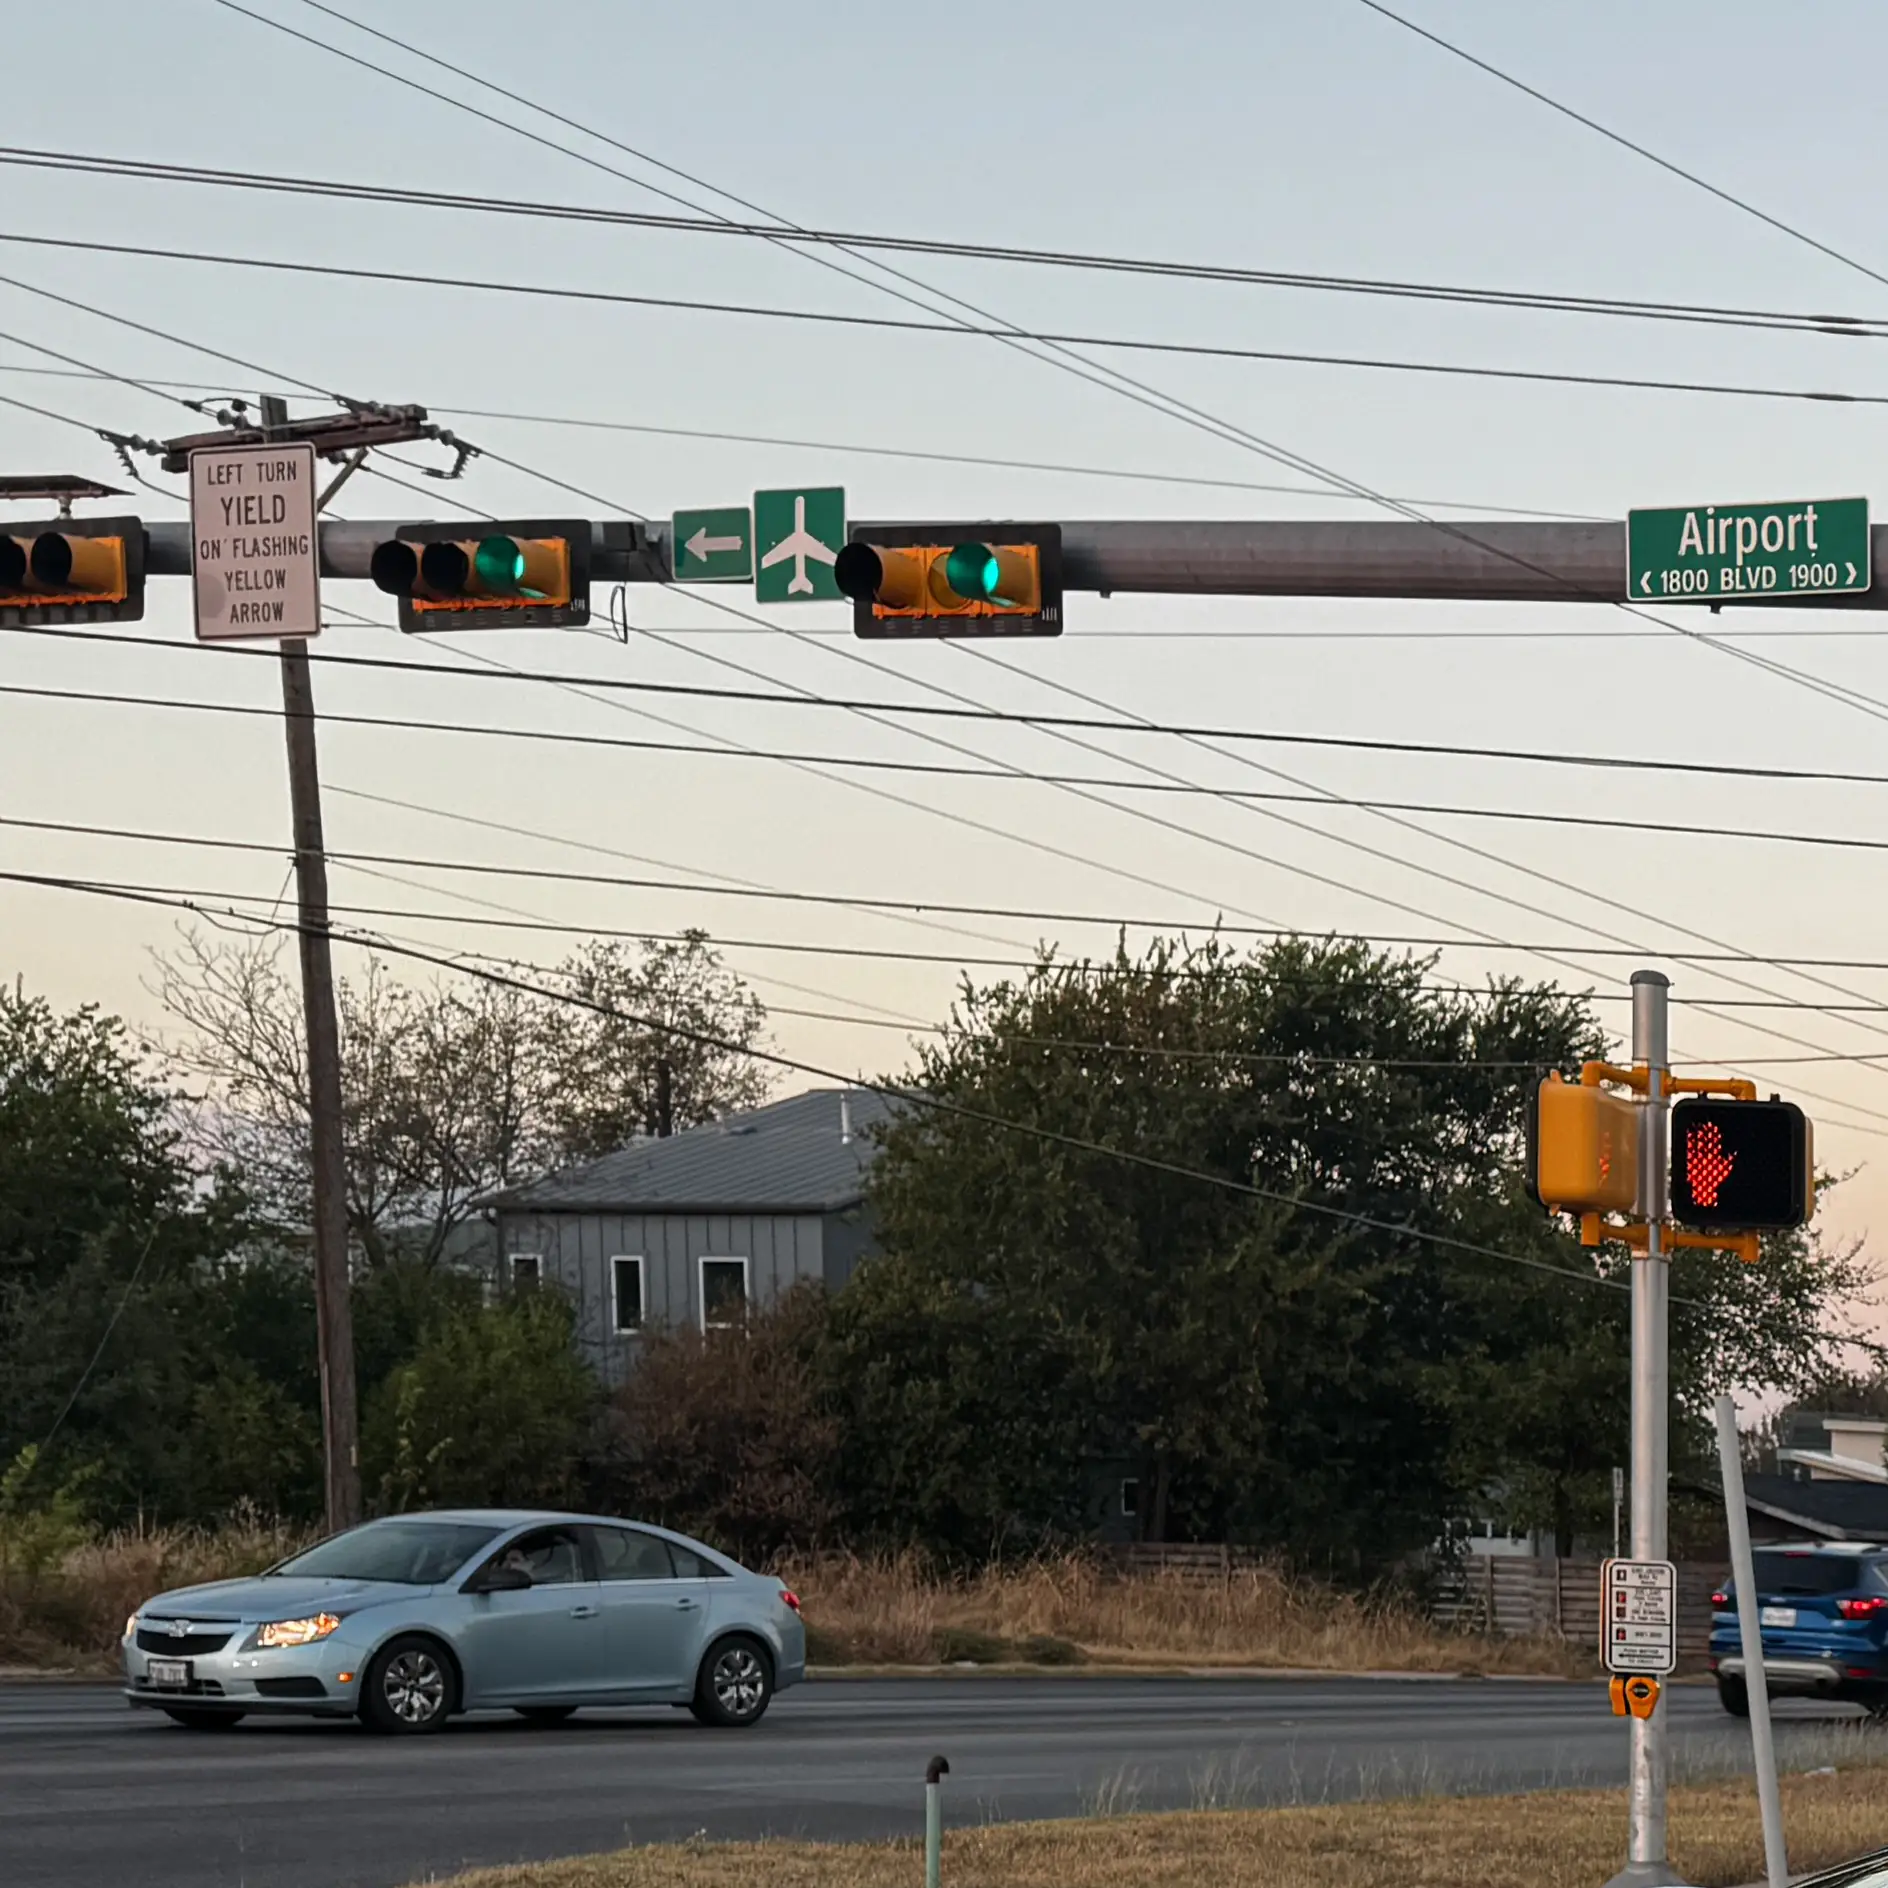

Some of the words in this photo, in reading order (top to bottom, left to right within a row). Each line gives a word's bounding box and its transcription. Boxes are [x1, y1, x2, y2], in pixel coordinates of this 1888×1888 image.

[207, 463, 243, 486] LEFT
[256, 460, 297, 483] TURN
[220, 494, 286, 526] YIELD
[200, 539, 221, 560] ON
[232, 535, 309, 559] FLASHING
[1677, 504, 1819, 567] Airport
[224, 569, 286, 592] YELLOW
[1660, 568, 1709, 594] 1800
[1720, 565, 1777, 591] BLVD
[1788, 563, 1838, 588] 1900
[229, 601, 284, 624] ARROW
